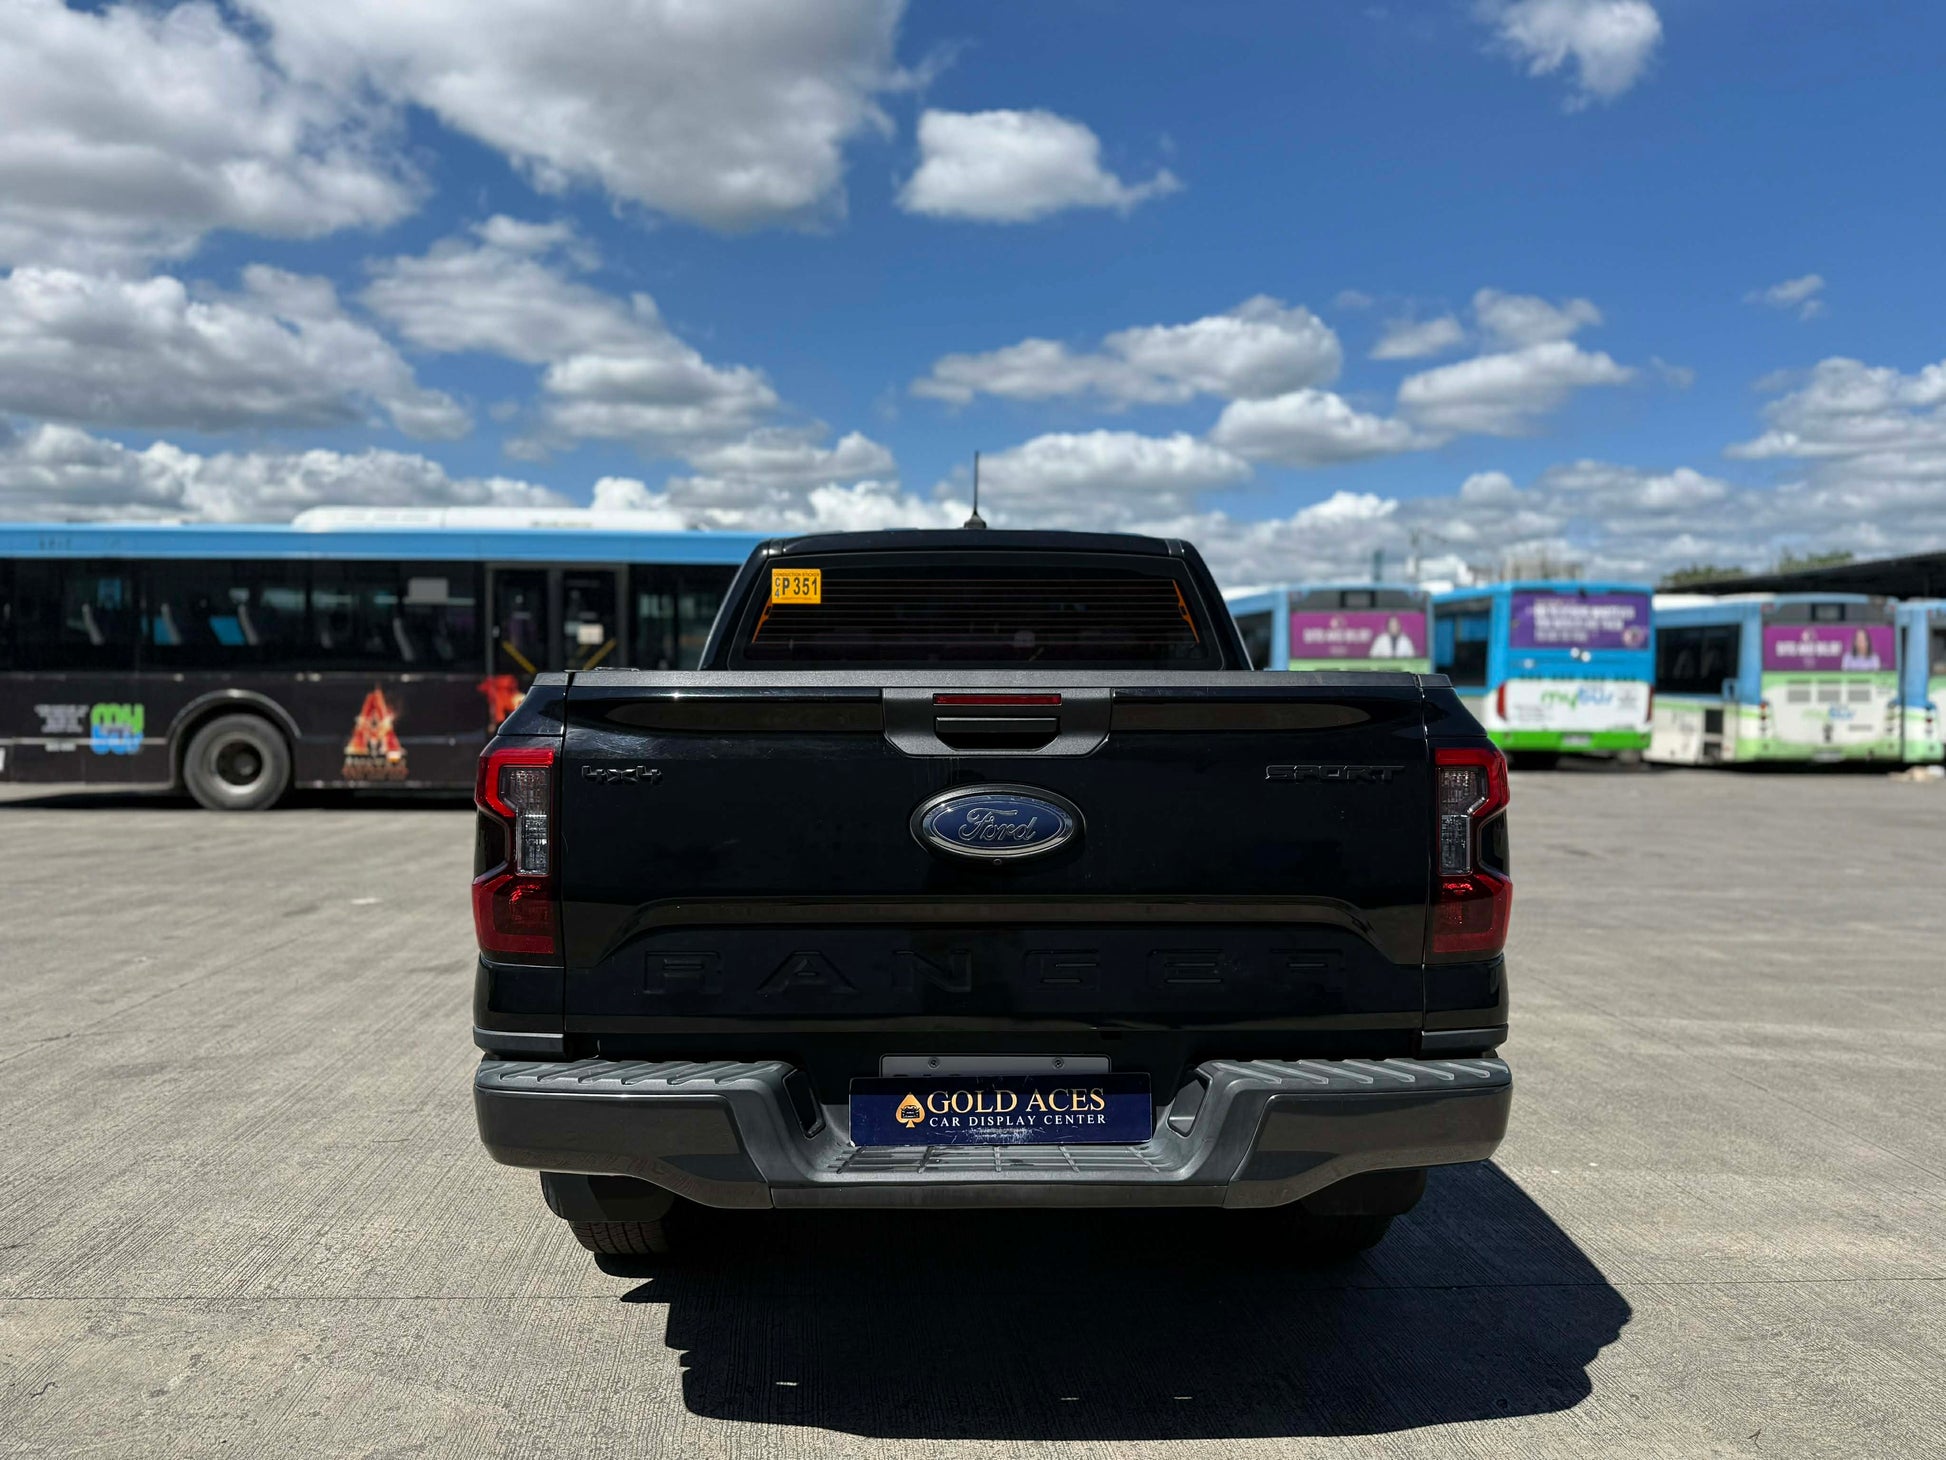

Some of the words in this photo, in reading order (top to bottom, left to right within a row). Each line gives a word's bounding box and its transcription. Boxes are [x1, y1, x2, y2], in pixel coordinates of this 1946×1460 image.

[1264, 764, 1406, 784] SPORT
[958, 807, 1038, 841] Ford
[643, 950, 1344, 995] RANGER
[927, 1089, 1017, 1114] GOLD
[1025, 1087, 1105, 1112] ACES
[929, 1117, 961, 1128] CAR
[968, 1115, 1036, 1127] DISPLAY
[1043, 1113, 1106, 1125] CENTER
